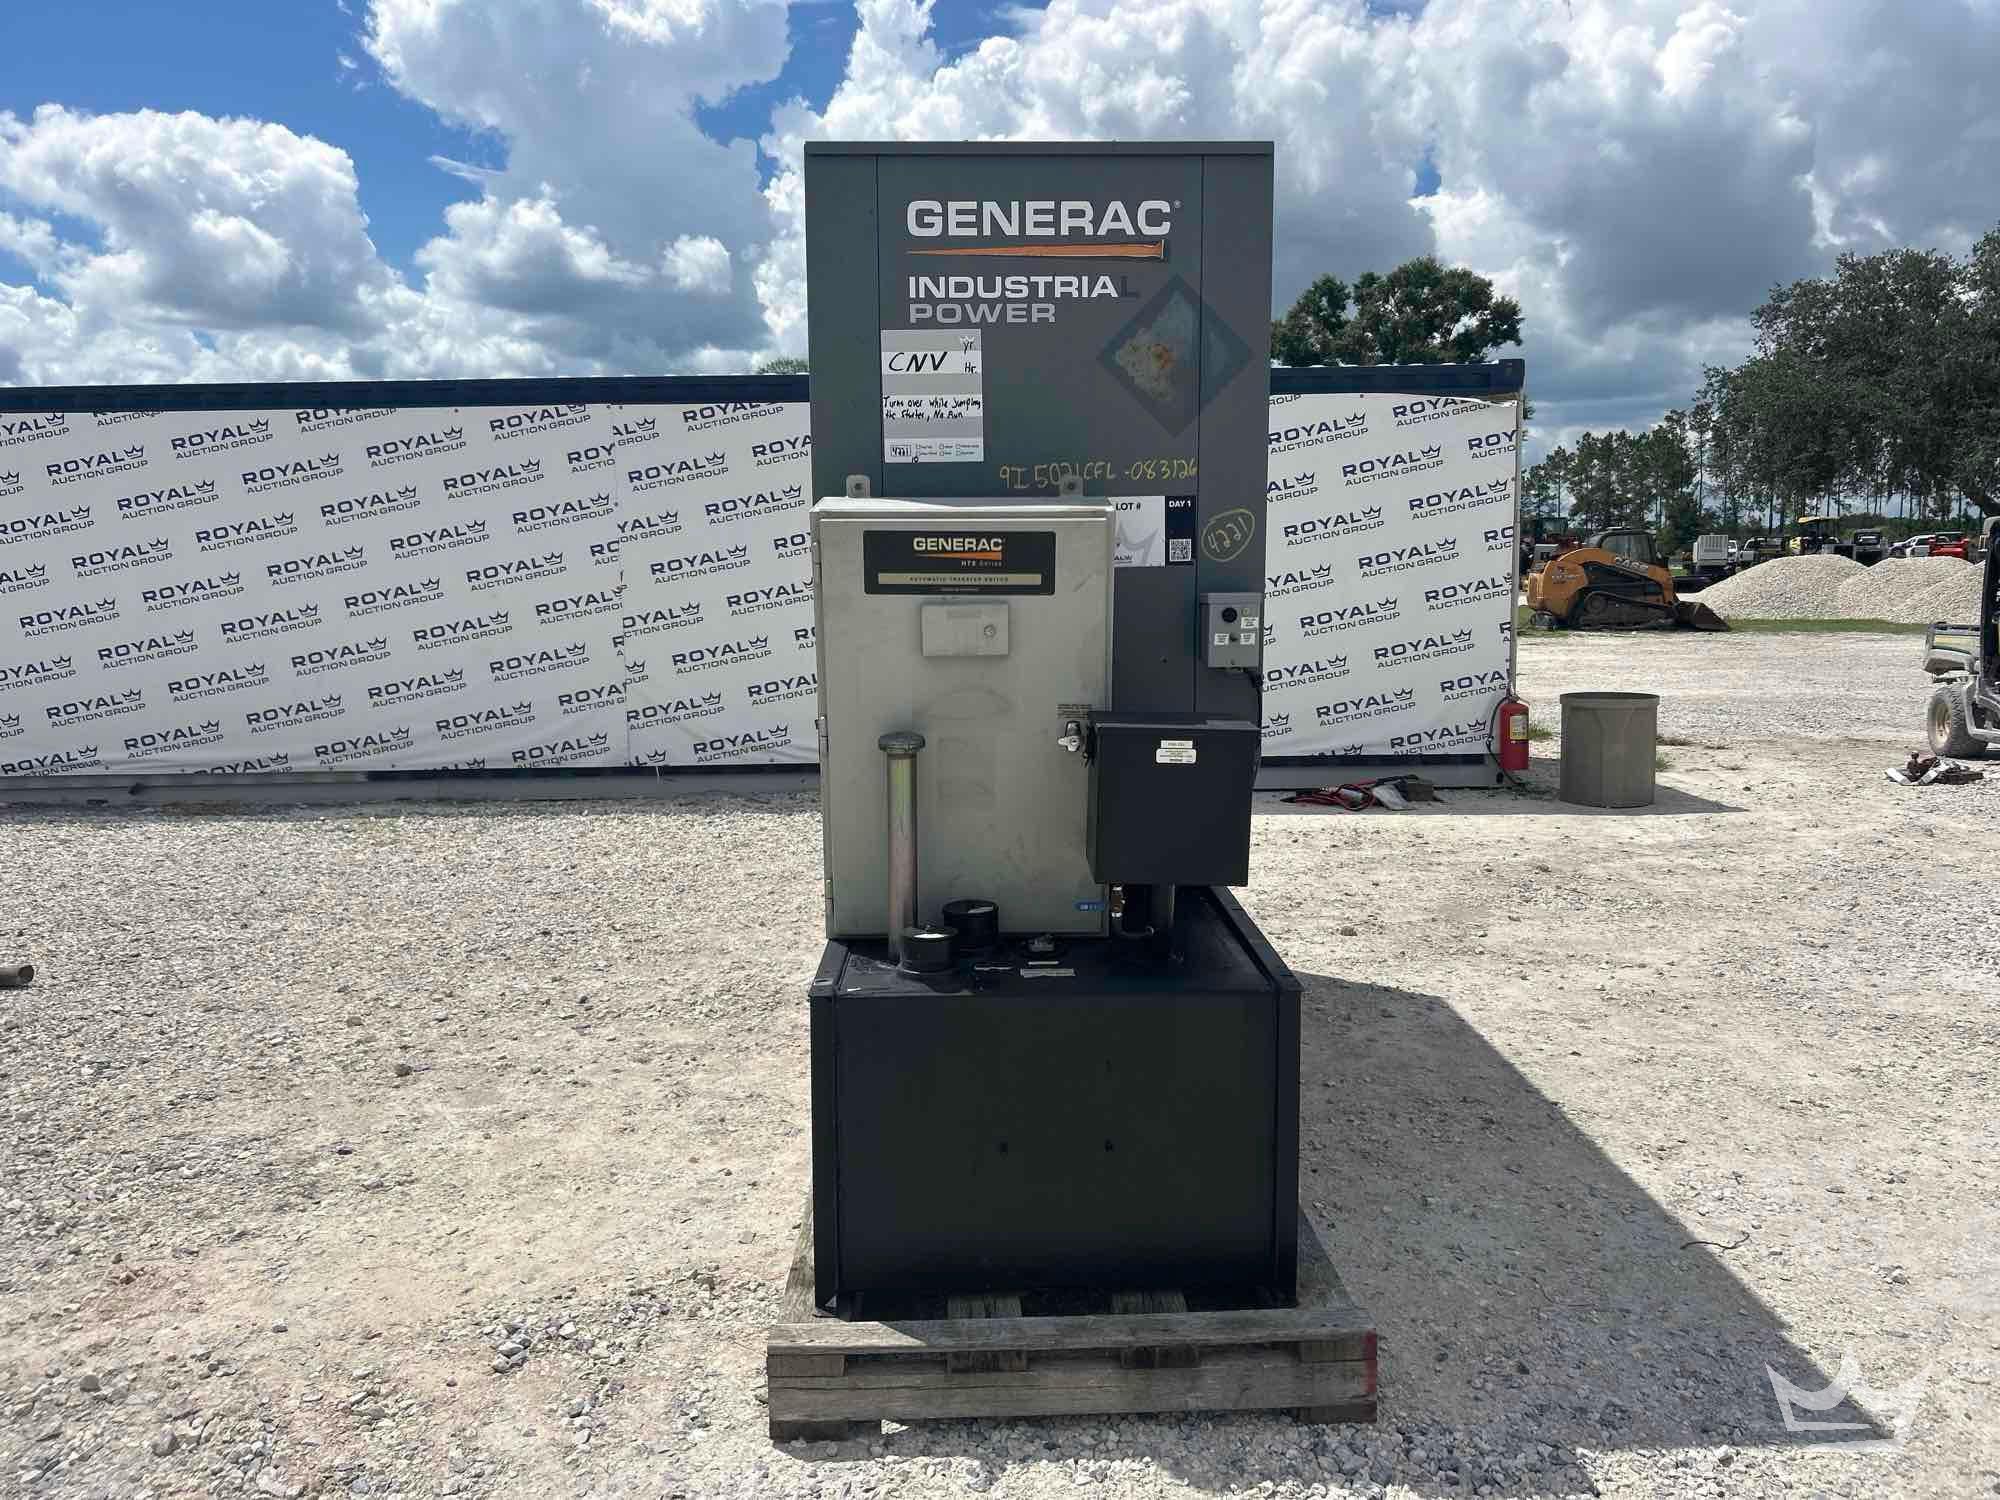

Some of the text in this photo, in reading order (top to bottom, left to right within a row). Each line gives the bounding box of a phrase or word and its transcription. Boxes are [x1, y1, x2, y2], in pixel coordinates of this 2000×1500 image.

[907, 200, 1171, 237] GENERAC
[909, 303, 1056, 323] POWER
[888, 351, 948, 372] CNV
[907, 399, 923, 408] over
[490, 407, 568, 432] ROYAL
[494, 415, 590, 441] AUCTION GROUP
[172, 426, 249, 450] ROYAL
[1268, 420, 1346, 445] ROYAL
[176, 434, 272, 460] AUCTION GROUP
[366, 434, 444, 458] ROYAL
[370, 442, 466, 468] AUCTION GROUP
[48, 452, 124, 477] ROYAL
[52, 460, 148, 486] AUCTION GROUP
[243, 460, 320, 485] ROYAL
[629, 459, 706, 483] ROYAL
[1343, 452, 1421, 477] ROYAL
[1345, 459, 1443, 486] AUCTION GROUP
[247, 468, 343, 494] AUCTION GROUP
[444, 466, 520, 491] ROYAL
[448, 474, 544, 500] AUCTION GROUP
[632, 466, 729, 492] AUCTION GROUP
[118, 486, 195, 511] ROYAL
[122, 494, 218, 520] AUCTION GROUP
[321, 492, 398, 518] ROYAL
[706, 492, 783, 516] ROYAL
[1116, 503, 1134, 511] LOT
[1169, 500, 1185, 508] DAY
[1410, 486, 1488, 510] ROYAL
[1412, 492, 1510, 520] AUCTION GROUP
[325, 500, 421, 526] AUCTION GROUP
[513, 500, 590, 525] ROYAL
[517, 508, 613, 534] AUCTION GROUP
[709, 499, 806, 525] AUCTION GROUP
[197, 518, 274, 544] ROYAL
[1208, 516, 1248, 553] 4221
[1284, 512, 1362, 538] ROYAL
[1286, 520, 1384, 546] AUCTION GROUP
[201, 526, 297, 552] AUCTION GROUP
[390, 526, 466, 551] ROYAL
[394, 534, 490, 560] AUCTION GROUP
[913, 537, 1002, 551] GENERAC
[72, 544, 150, 570] ROYAL
[76, 552, 172, 578] AUCTION GROUP
[268, 552, 344, 578] ROYAL
[651, 552, 728, 576] ROYAL
[1359, 544, 1437, 569] ROYAL
[1361, 551, 1459, 578] AUCTION GROUP
[272, 560, 368, 586] AUCTION GROUP
[466, 558, 544, 583] ROYAL
[470, 566, 566, 592] AUCTION GROUP
[654, 558, 751, 584] AUCTION GROUP
[143, 578, 220, 604] ROYAL
[147, 586, 243, 612] AUCTION GROUP
[344, 584, 422, 609] ROYAL
[727, 584, 804, 608] ROYAL
[1426, 578, 1504, 602] ROYAL
[20, 604, 97, 629] ROYAL
[536, 592, 614, 616] ROYAL
[1300, 604, 1378, 628] ROYAL
[24, 612, 120, 638] AUCTION GROUP
[222, 610, 299, 635] ROYAL
[226, 618, 322, 644] AUCTION GROUP
[414, 616, 490, 642] ROYAL
[98, 636, 175, 661] ROYAL
[419, 624, 512, 650] AUCTION GROUP
[1374, 635, 1452, 660] ROYAL
[102, 644, 198, 670] AUCTION GROUP
[292, 642, 368, 668] ROYAL
[297, 650, 390, 676] AUCTION GROUP
[490, 650, 567, 674] ROYAL
[672, 642, 750, 666] ROYAL
[676, 649, 772, 675] AUCTION GROUP
[1376, 642, 1474, 669] AUCTION GROUP
[168, 669, 246, 694] ROYAL
[493, 656, 590, 682] AUCTION GROUP
[172, 677, 268, 703] AUCTION GROUP
[368, 674, 444, 698] ROYAL
[47, 694, 123, 719] ROYAL
[247, 700, 323, 724] ROYAL
[626, 697, 702, 722] ROYAL
[1316, 694, 1394, 718] ROYAL
[252, 708, 345, 732] AUCTION GROUP
[436, 706, 512, 732] ROYAL
[442, 714, 534, 740] AUCTION GROUP
[125, 725, 201, 750] ROYAL
[315, 732, 391, 757] ROYAL
[693, 730, 769, 754] ROYAL
[1391, 725, 1466, 749] ROYAL
[1, 751, 78, 774] ROYAL
[320, 740, 413, 765] AUCTION GROUP
[511, 737, 588, 763] ROYAL
